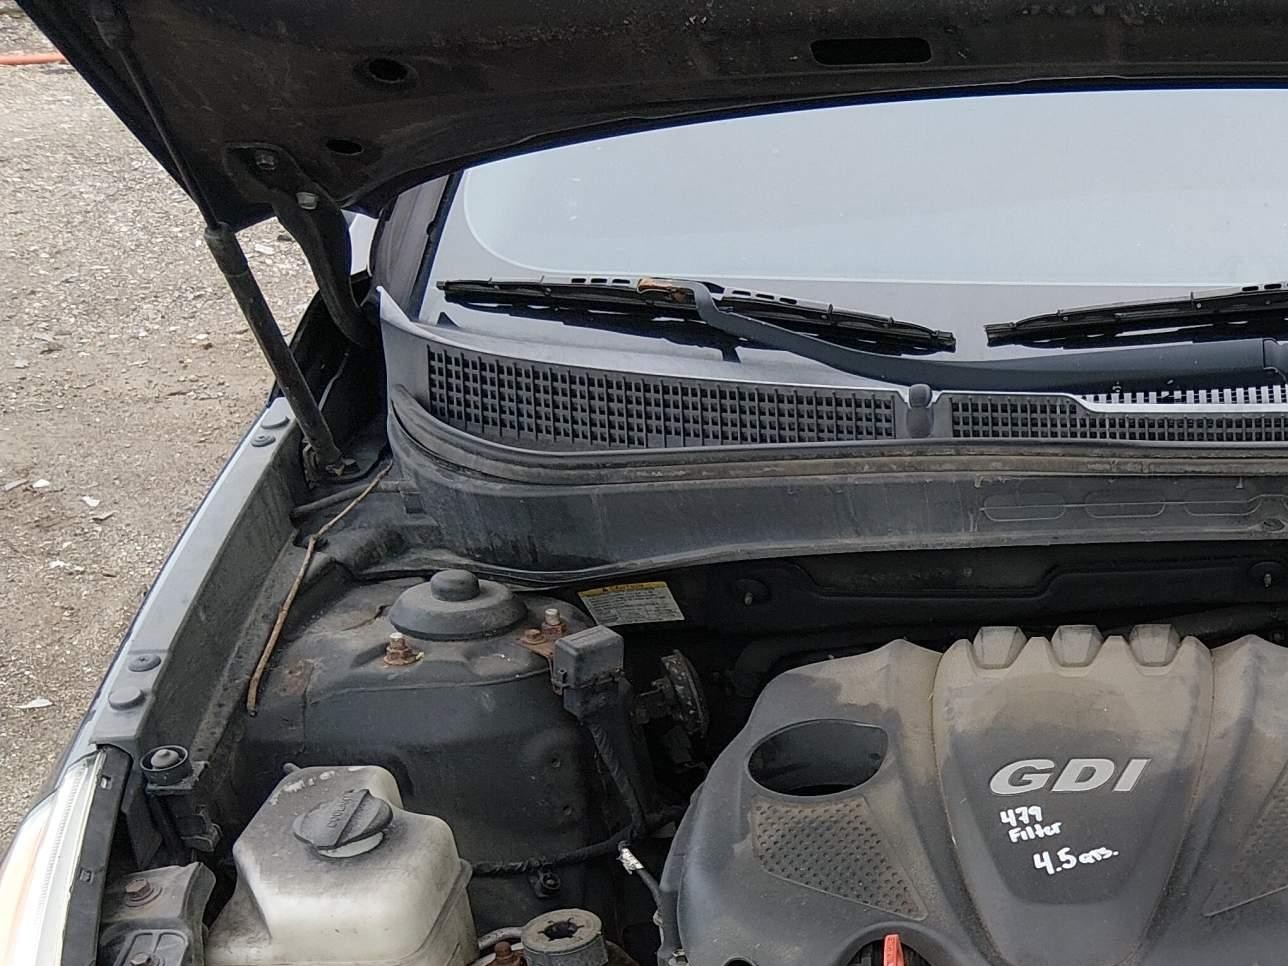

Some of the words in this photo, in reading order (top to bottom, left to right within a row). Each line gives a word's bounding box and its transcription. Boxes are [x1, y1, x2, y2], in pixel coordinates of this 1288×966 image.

[989, 758, 1151, 795] GDI
[1000, 805, 1043, 827] 479
[1008, 822, 1063, 843] Filter
[1032, 847, 1077, 875] 4.5
